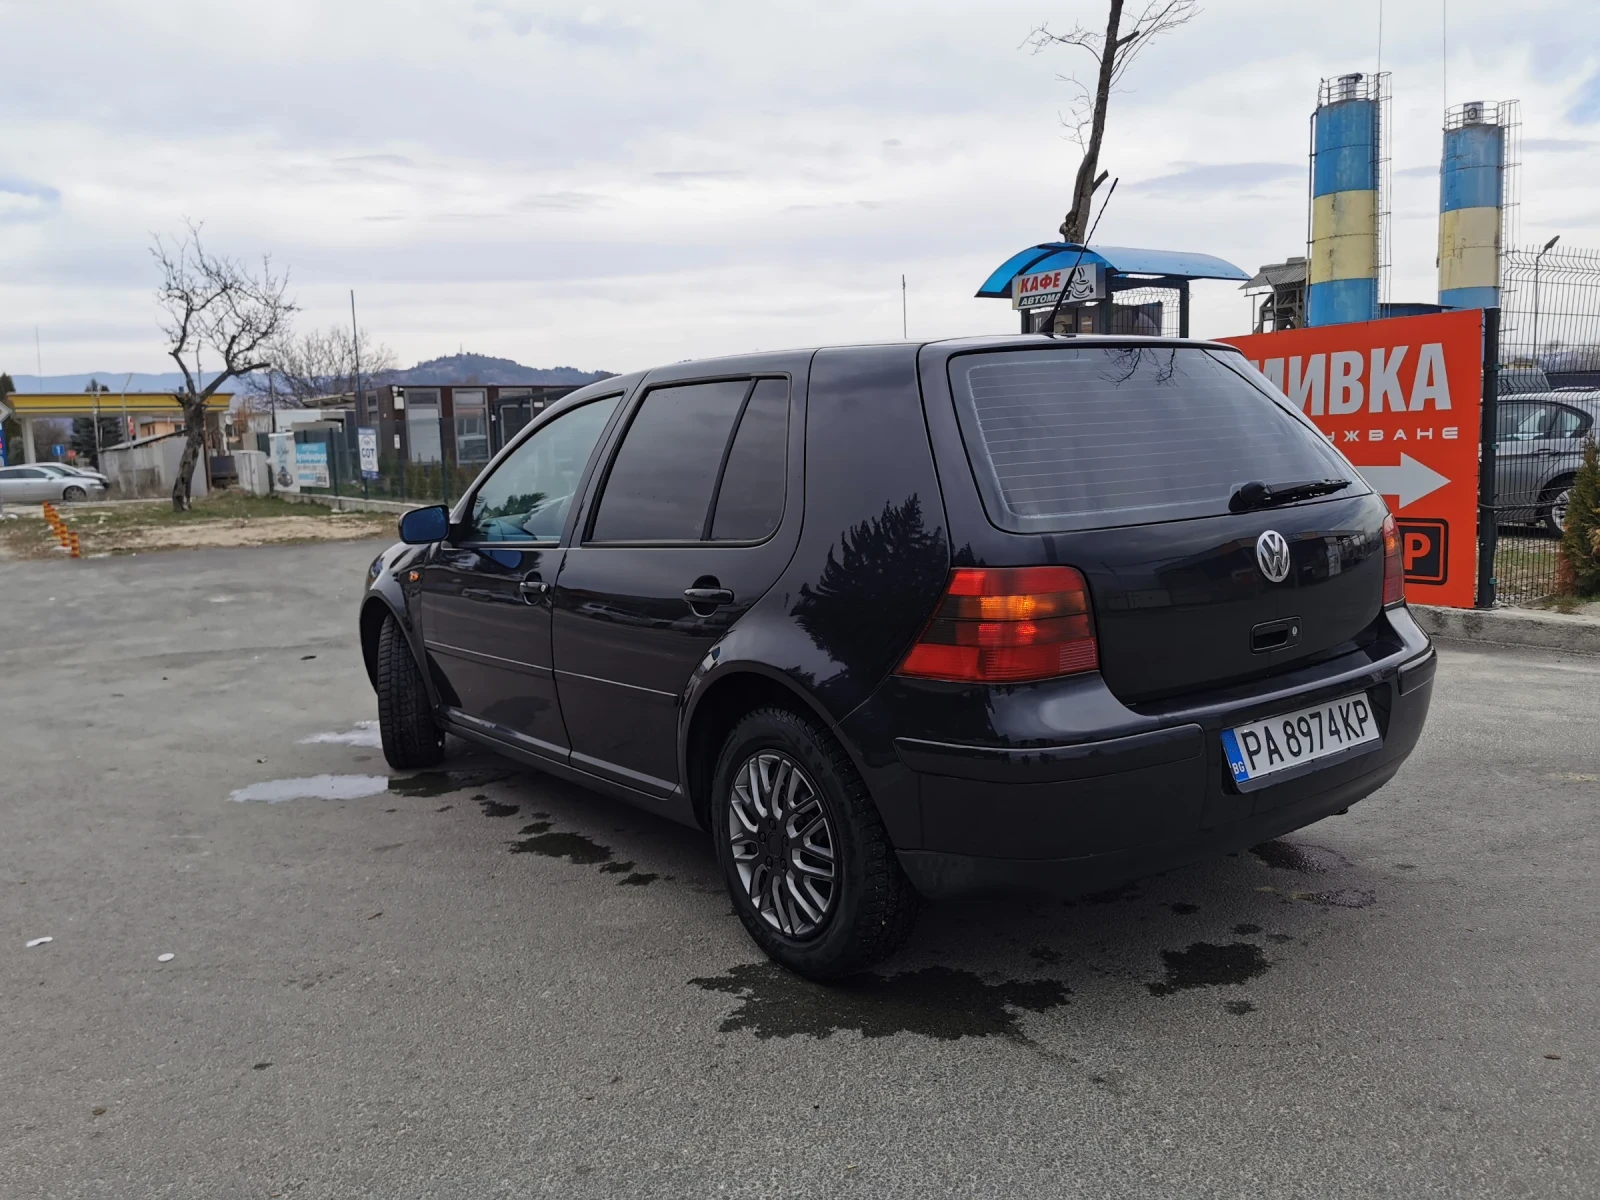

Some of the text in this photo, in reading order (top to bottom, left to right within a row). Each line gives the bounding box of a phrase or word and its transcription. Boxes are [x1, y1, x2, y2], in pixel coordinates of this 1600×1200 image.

[1020, 272, 1061, 293] КАФЕ
[1403, 532, 1431, 570] P
[1232, 761, 1246, 775] BG
